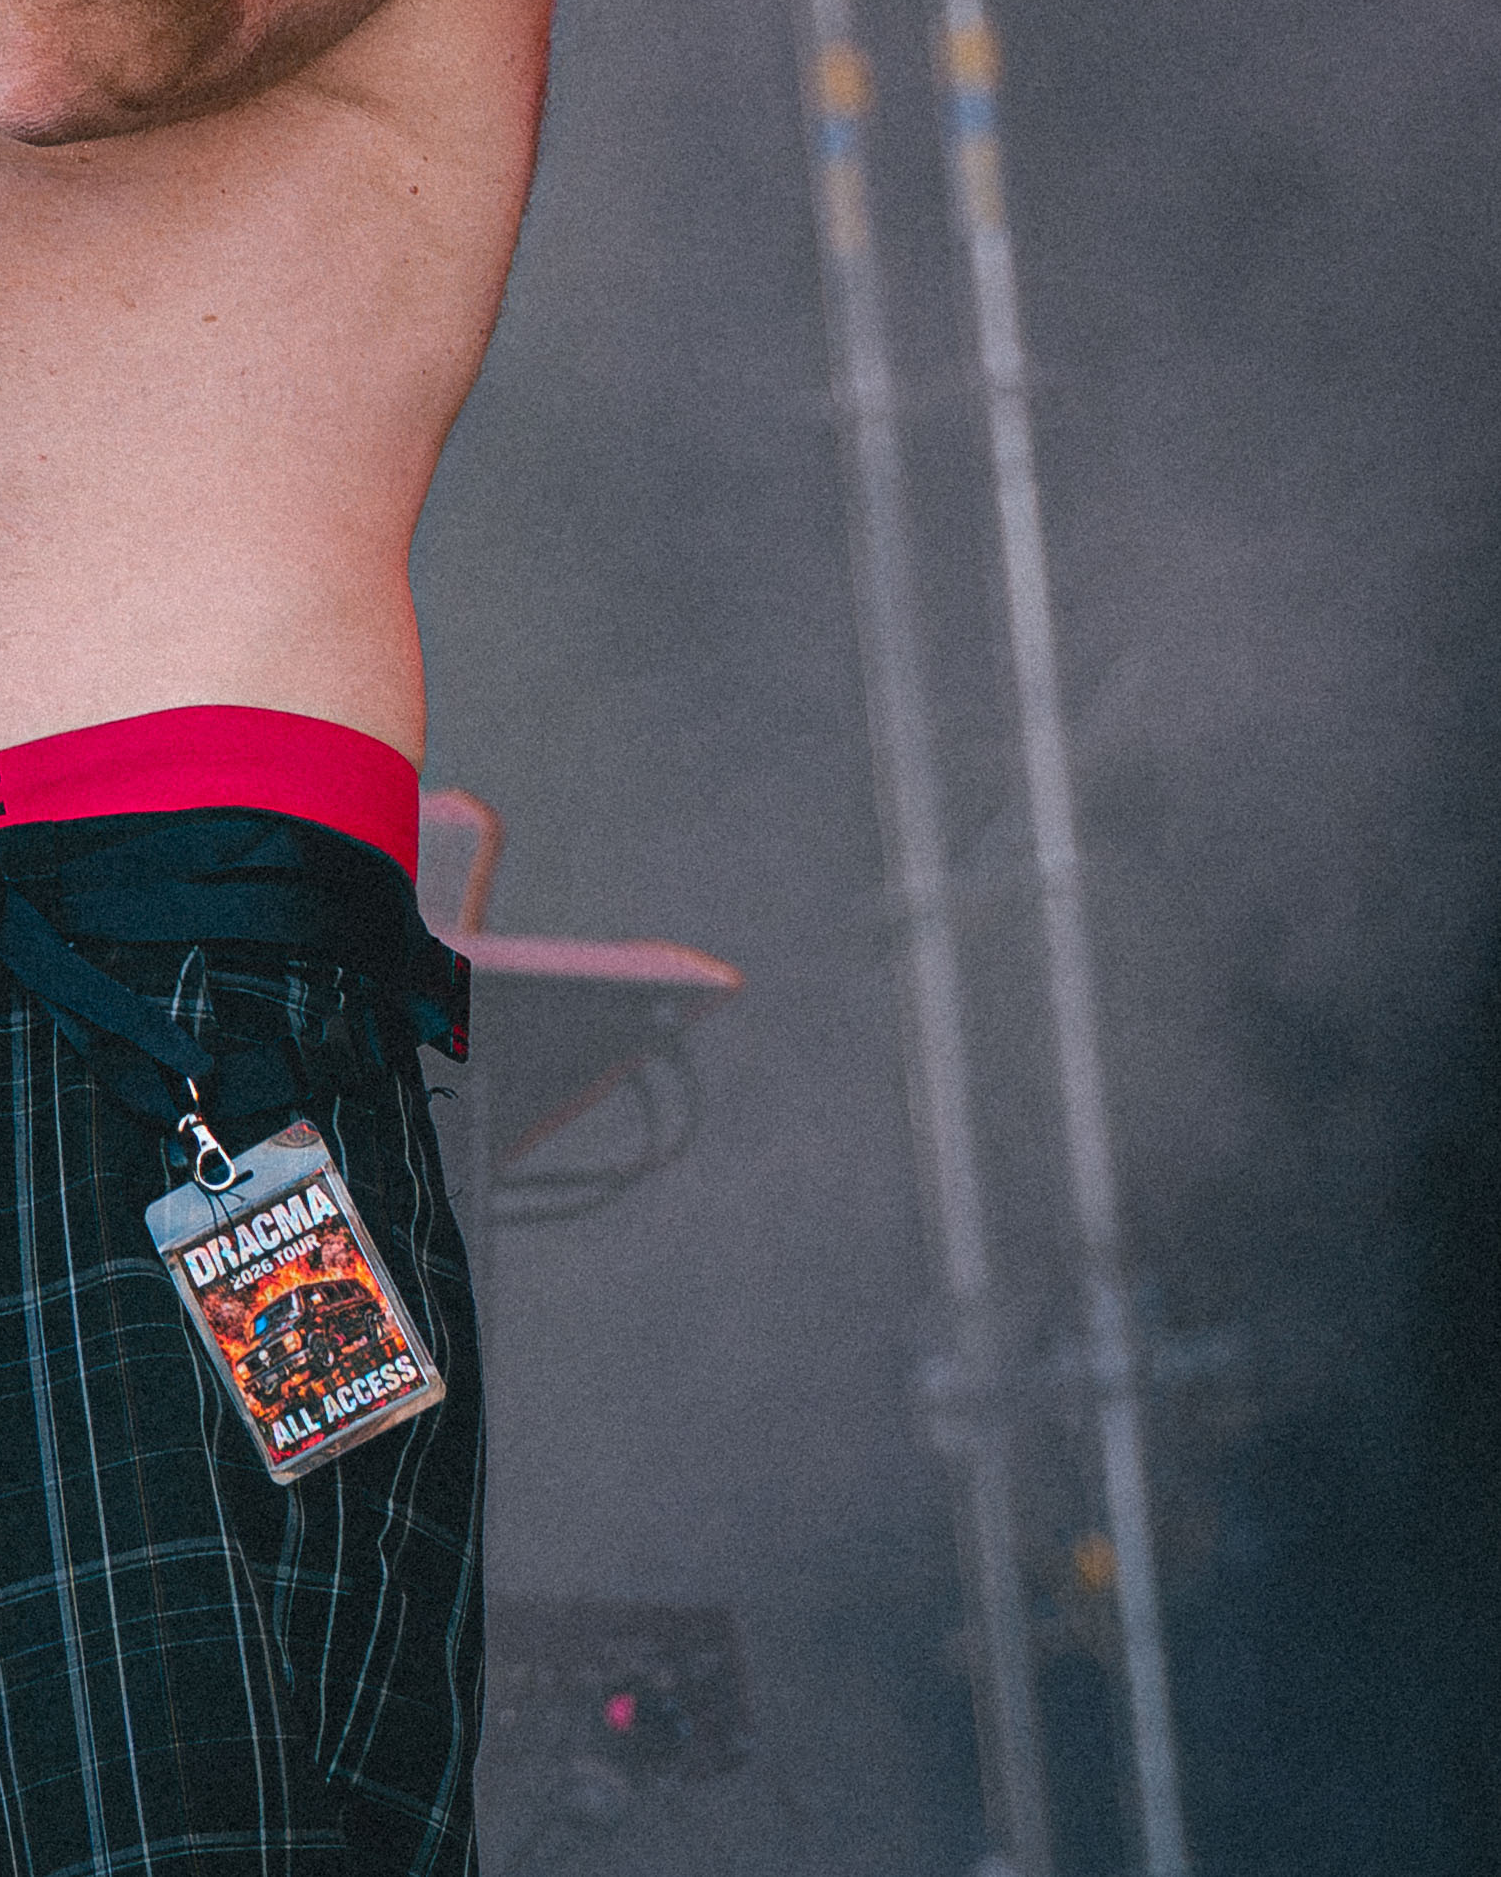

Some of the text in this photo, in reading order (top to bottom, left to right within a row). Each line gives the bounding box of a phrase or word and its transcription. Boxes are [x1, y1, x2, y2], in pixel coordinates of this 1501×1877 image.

[183, 1184, 338, 1288] DRACMA
[230, 1233, 321, 1291] 2026 TOUR
[272, 1355, 417, 1449] ALL ACCESS
